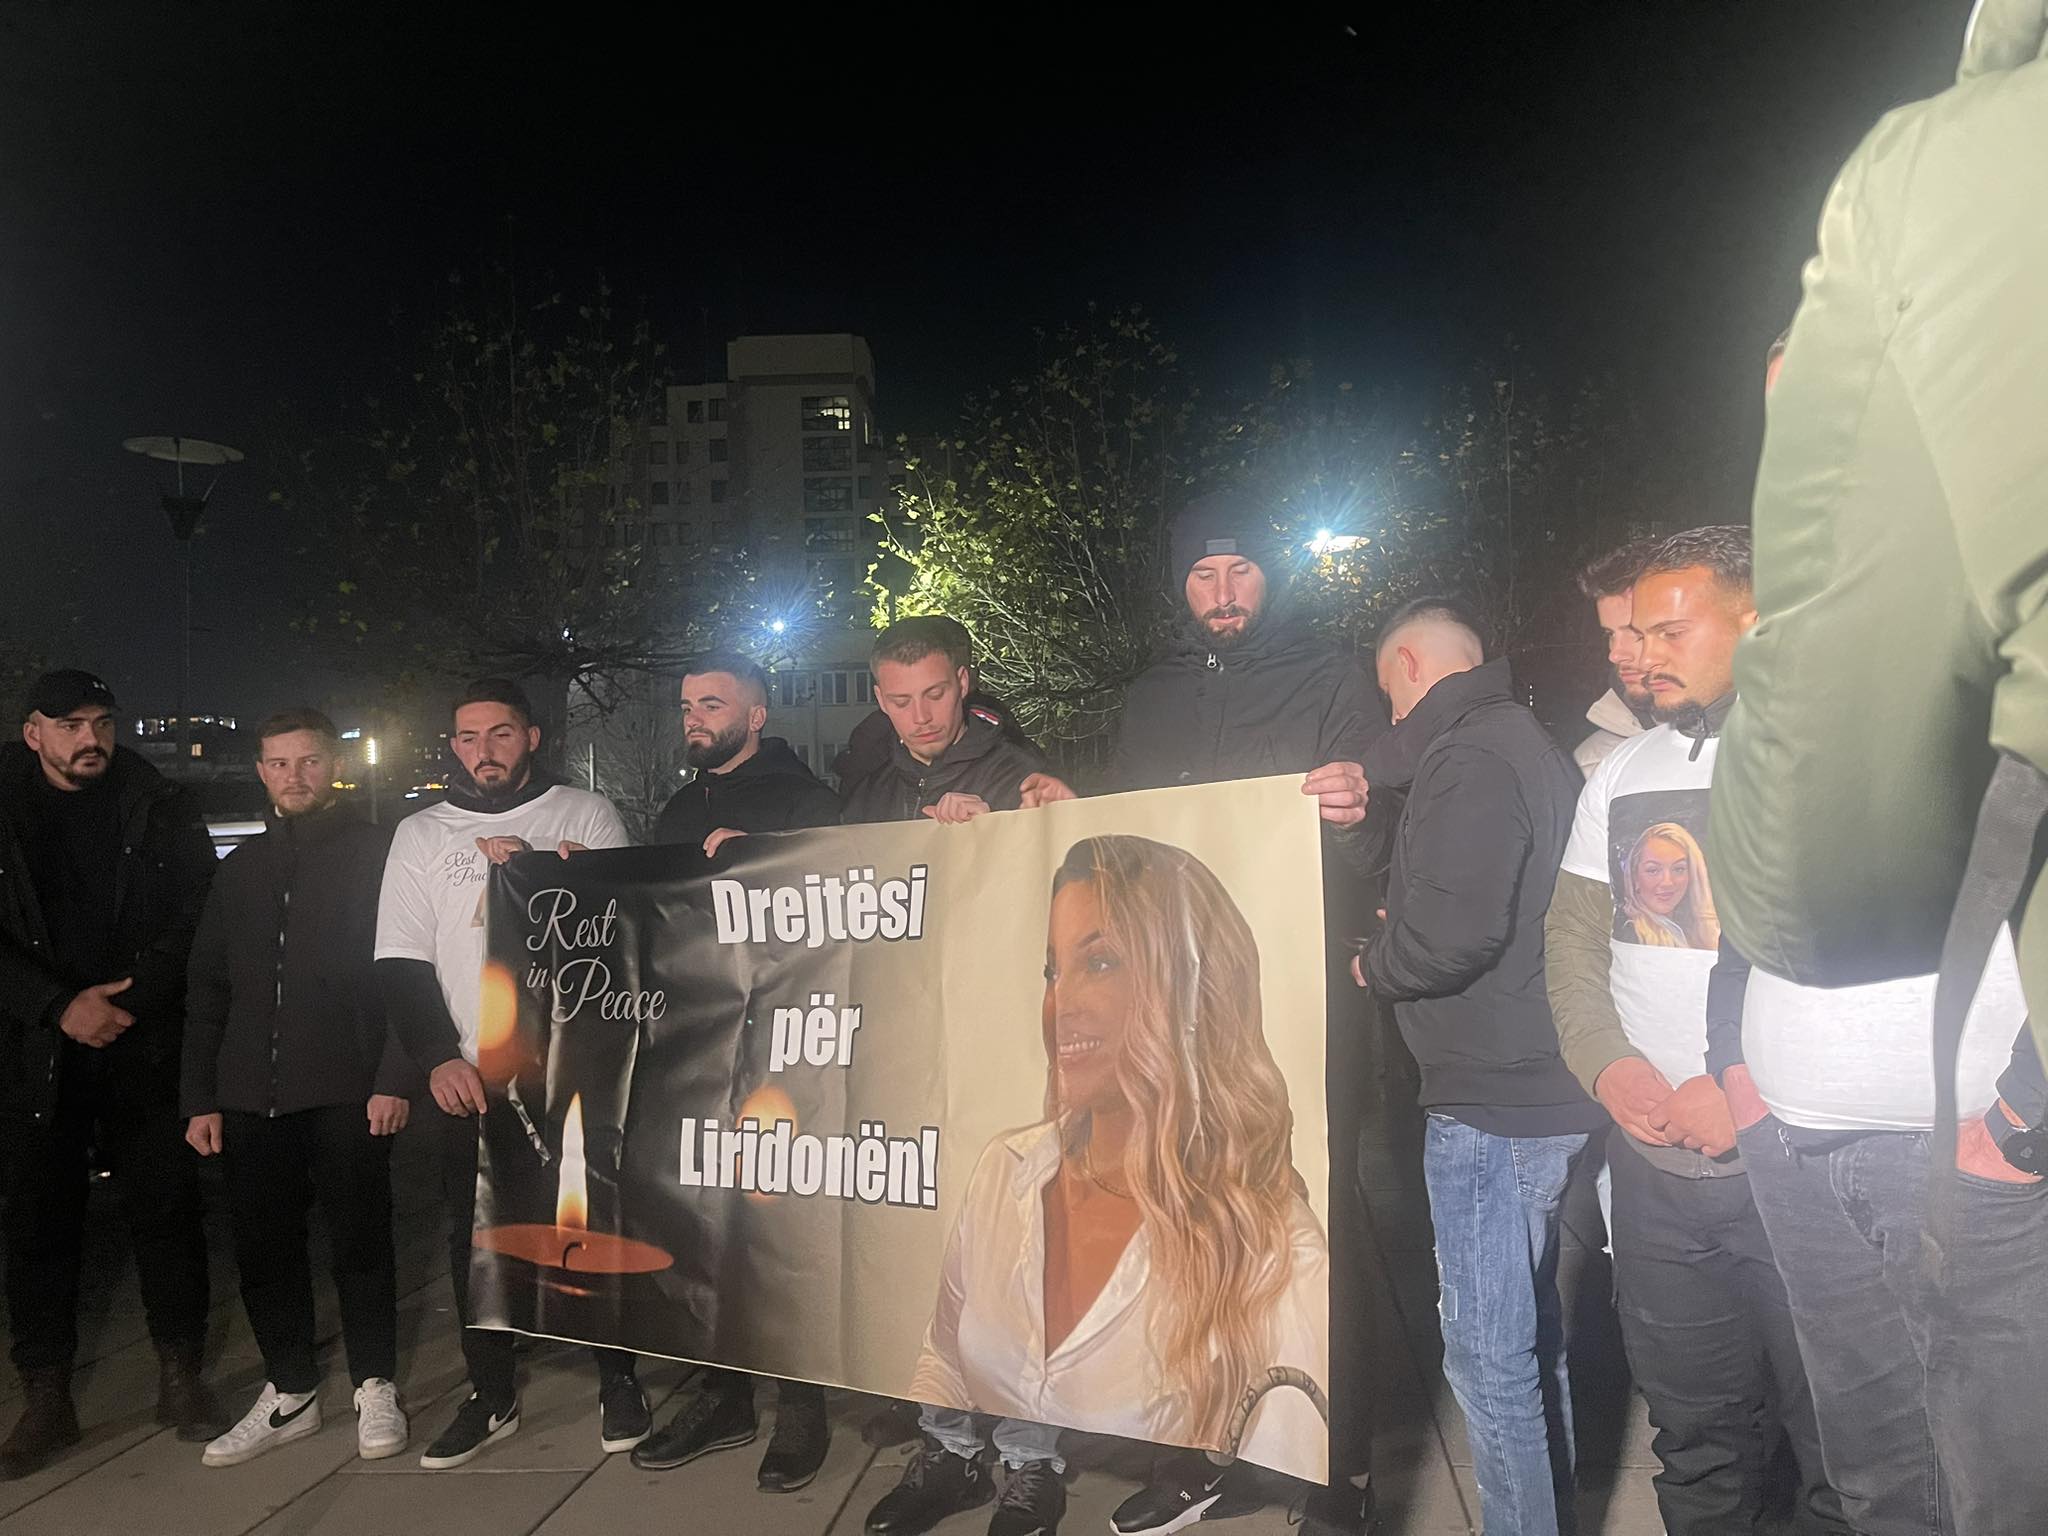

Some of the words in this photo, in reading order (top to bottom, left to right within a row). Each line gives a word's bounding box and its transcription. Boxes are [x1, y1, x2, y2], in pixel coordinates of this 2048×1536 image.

[445, 851, 477, 871] Rest
[453, 866, 487, 887] Peac
[526, 888, 617, 951] Rest
[711, 865, 926, 948] Drejtësi
[526, 961, 551, 988] in
[551, 956, 667, 1023] Peace
[769, 993, 862, 1072] për
[679, 1117, 938, 1208] Liridonën!
